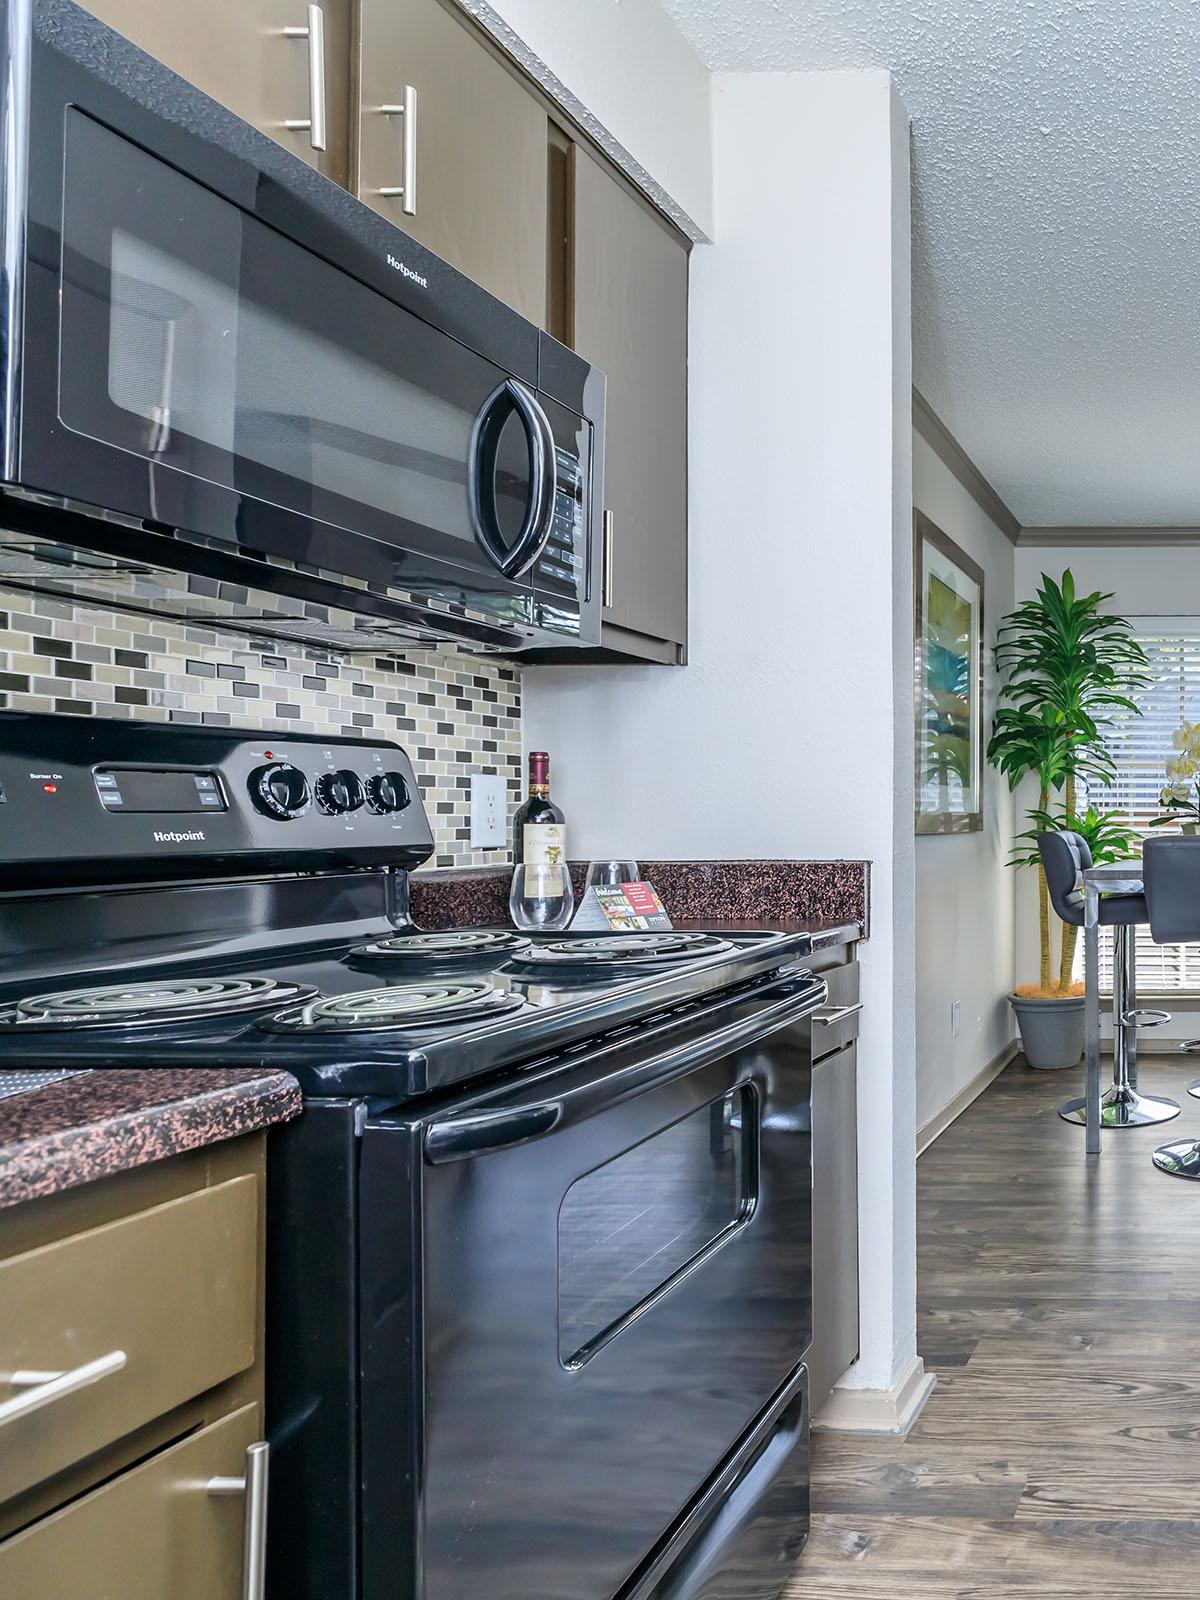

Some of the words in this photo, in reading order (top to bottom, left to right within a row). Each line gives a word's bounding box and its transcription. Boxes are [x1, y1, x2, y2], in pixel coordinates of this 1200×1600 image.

[387, 254, 428, 288] Hotpoint
[153, 831, 205, 842] Hotpoint
[595, 887, 623, 897] Welcome
